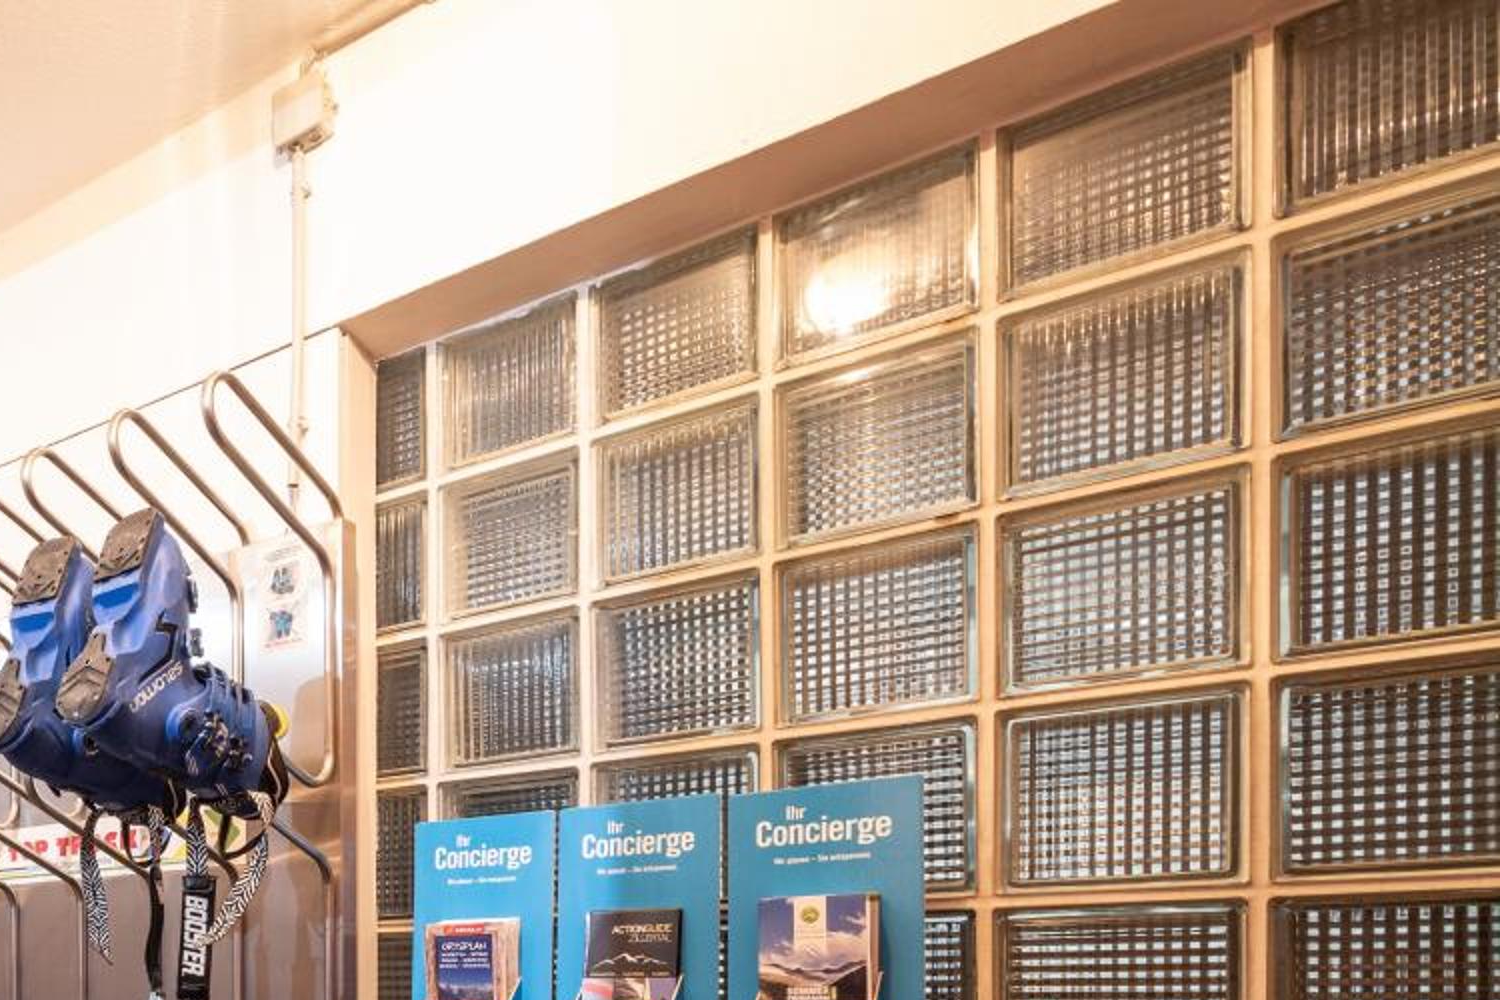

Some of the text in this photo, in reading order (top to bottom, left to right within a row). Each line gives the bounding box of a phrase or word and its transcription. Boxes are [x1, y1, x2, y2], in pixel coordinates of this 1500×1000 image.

[581, 829, 695, 860] Concierge
[756, 815, 892, 848] Concierge
[435, 842, 533, 871] Concierge
